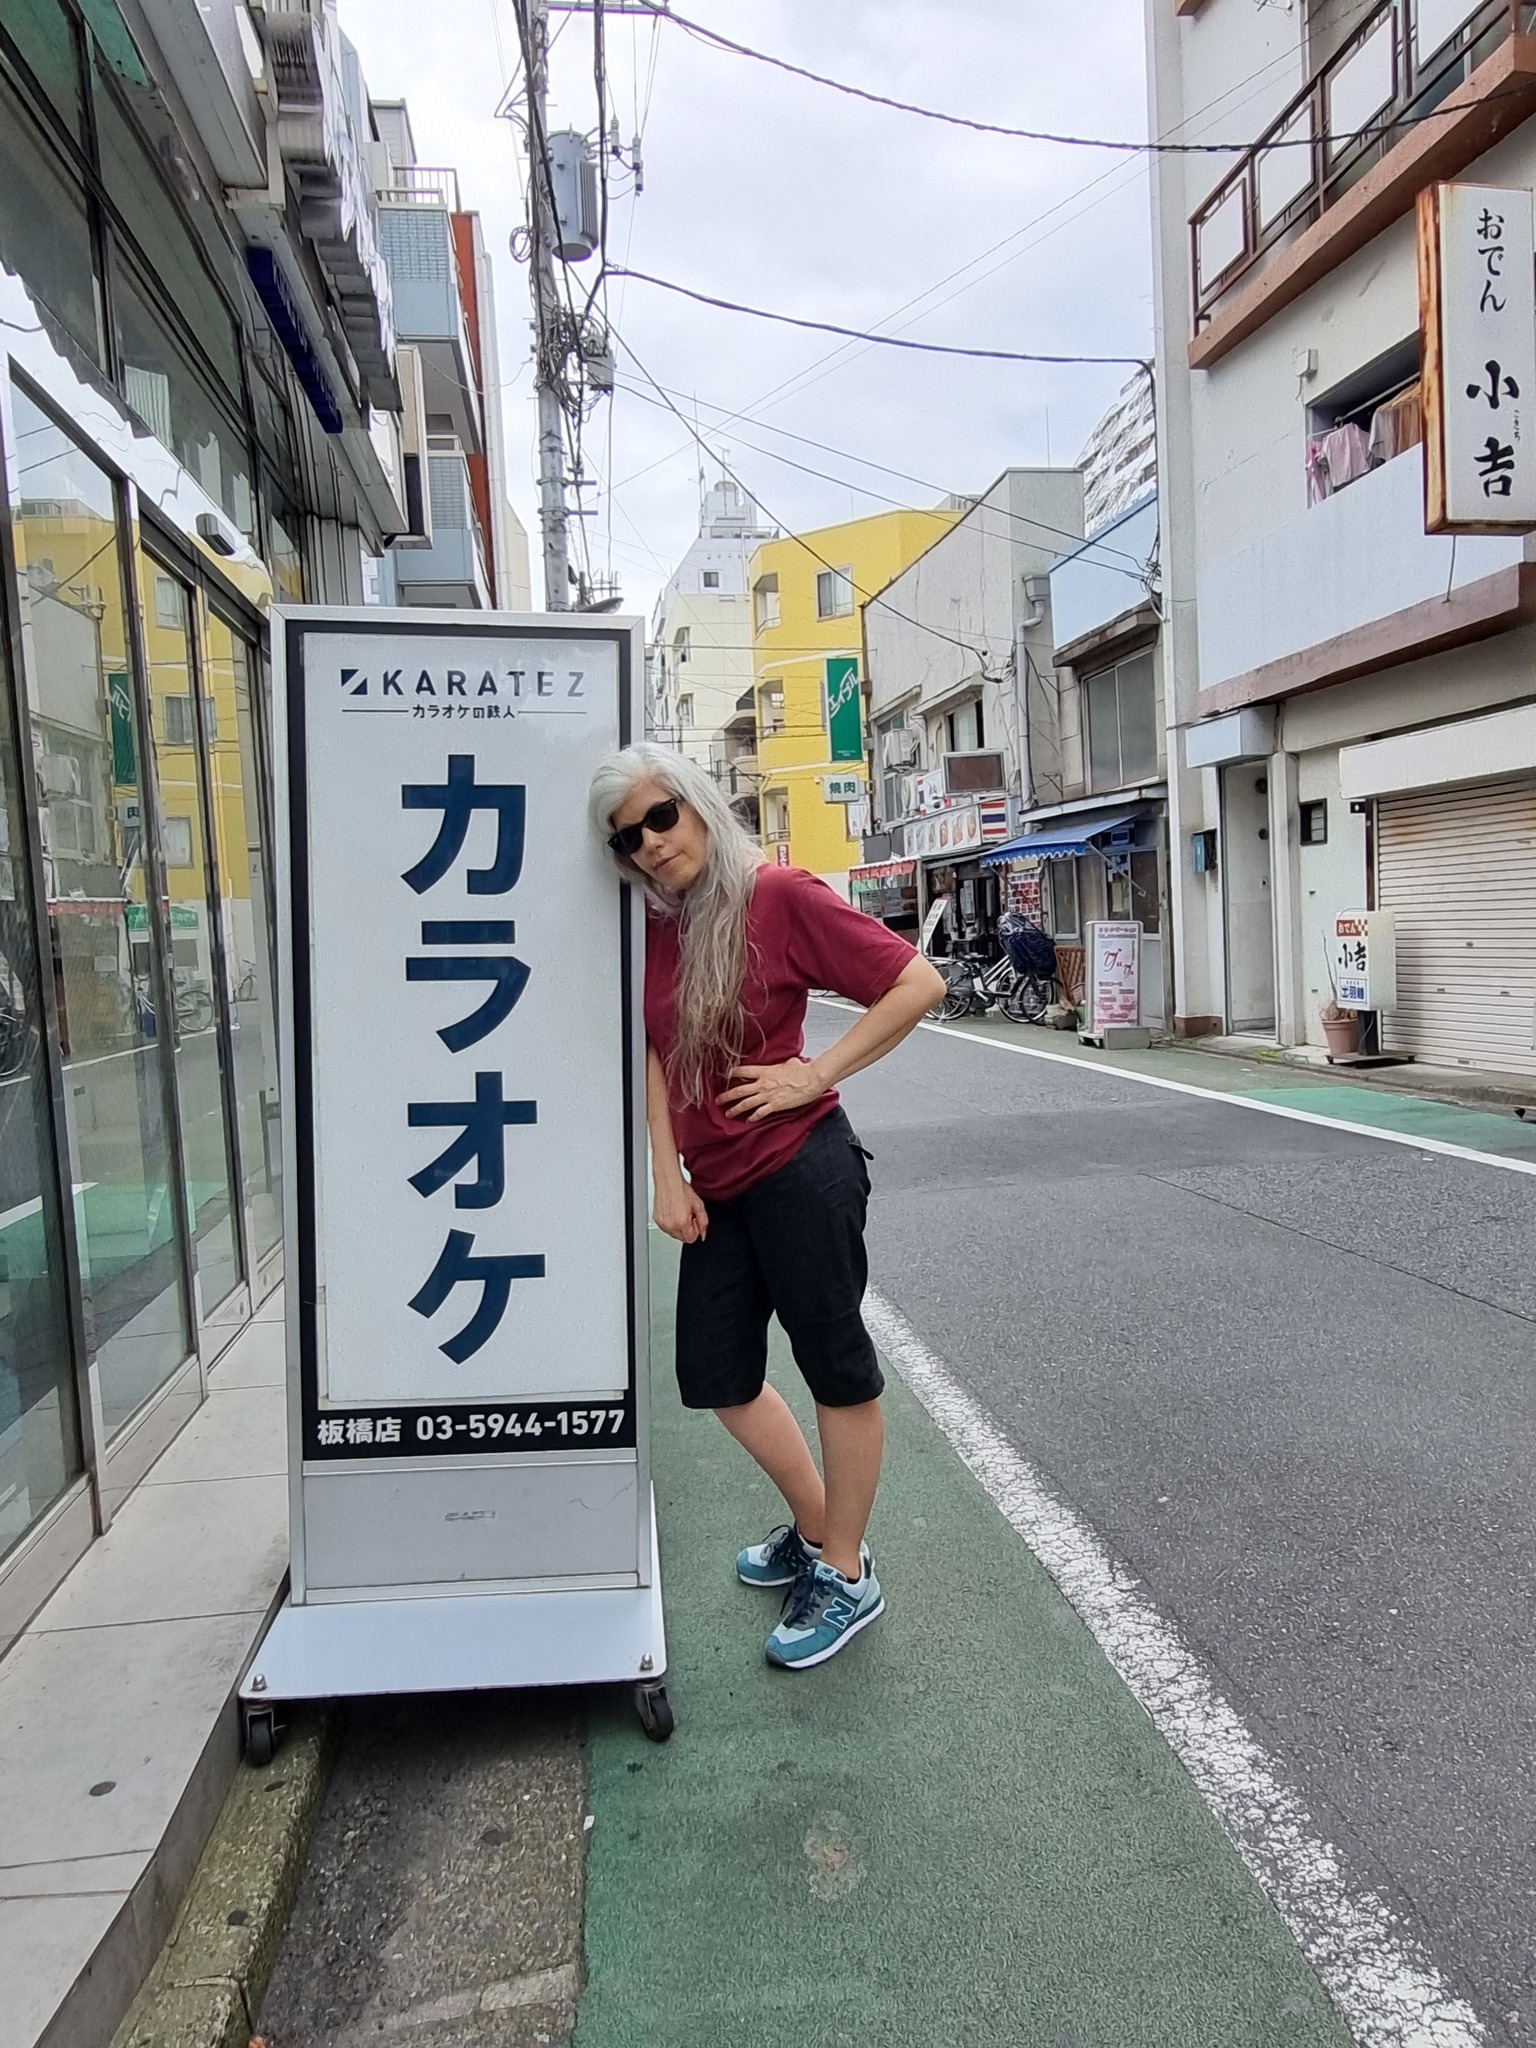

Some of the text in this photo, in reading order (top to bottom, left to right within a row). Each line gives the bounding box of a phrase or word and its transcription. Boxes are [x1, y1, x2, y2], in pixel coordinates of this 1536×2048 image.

[1476, 207, 1508, 313] おでん
[1465, 359, 1520, 498] 小吉
[382, 669, 585, 697] KARATEZ
[412, 704, 516, 719] カラオケの鉄人
[829, 781, 855, 794] 焼肉
[1338, 922, 1357, 934] おでん
[1338, 940, 1367, 971] 小吉
[400, 754, 546, 1365] カラオケ
[317, 1409, 625, 1445] 板橋店 03-5944-1577
[822, 1596, 855, 1629] N
